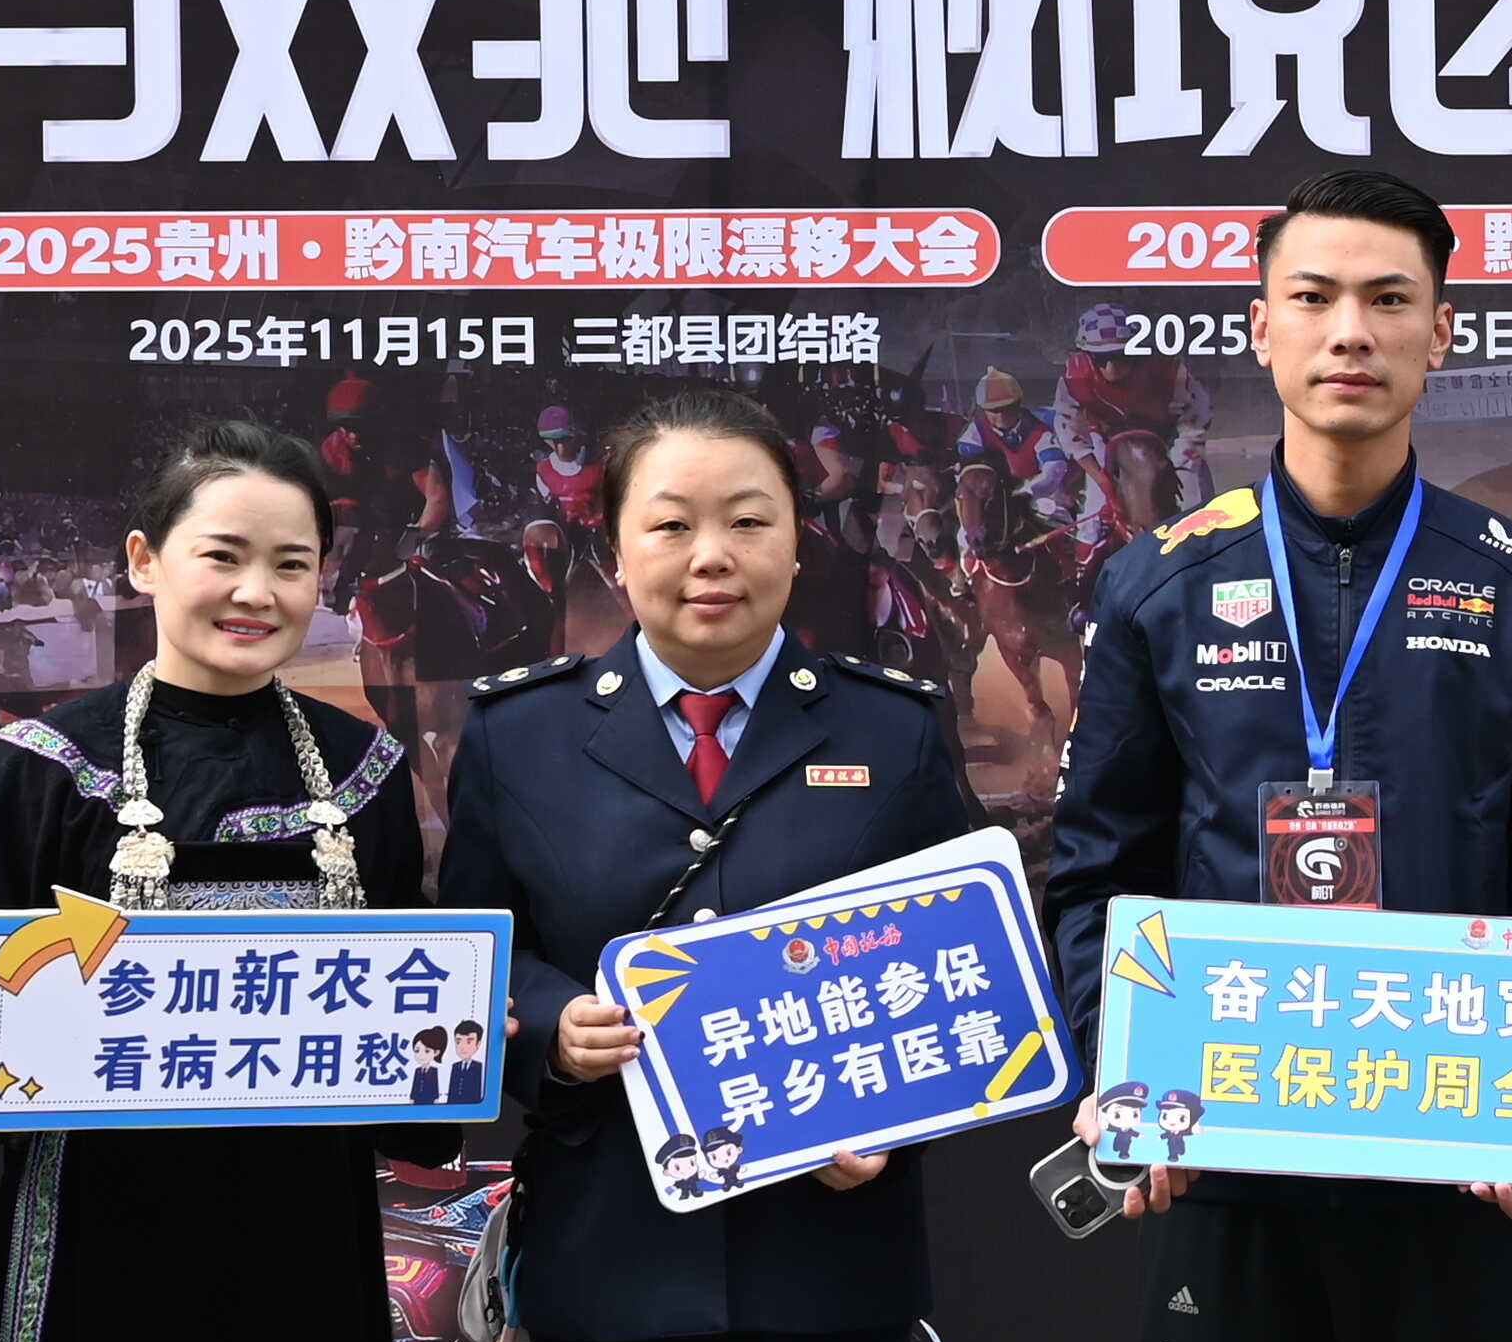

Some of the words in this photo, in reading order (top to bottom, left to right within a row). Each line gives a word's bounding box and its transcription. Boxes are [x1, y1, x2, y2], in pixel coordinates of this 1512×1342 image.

[128, 318, 536, 367] 2025年11月15日
[572, 313, 881, 366] 三都县团结路
[1217, 582, 1267, 600] TAG
[1407, 577, 1496, 600] ORACLE
[1215, 599, 1270, 621] HEUER
[1196, 640, 1262, 665] Mobil
[1405, 635, 1492, 658] HONDA
[1195, 674, 1287, 692] ORACLE
[97, 947, 451, 1017] 参加新农合
[699, 942, 992, 1068] 异地能参保
[93, 1031, 412, 1093] 看病不用愁
[717, 1008, 1010, 1134] 异乡有医靠
